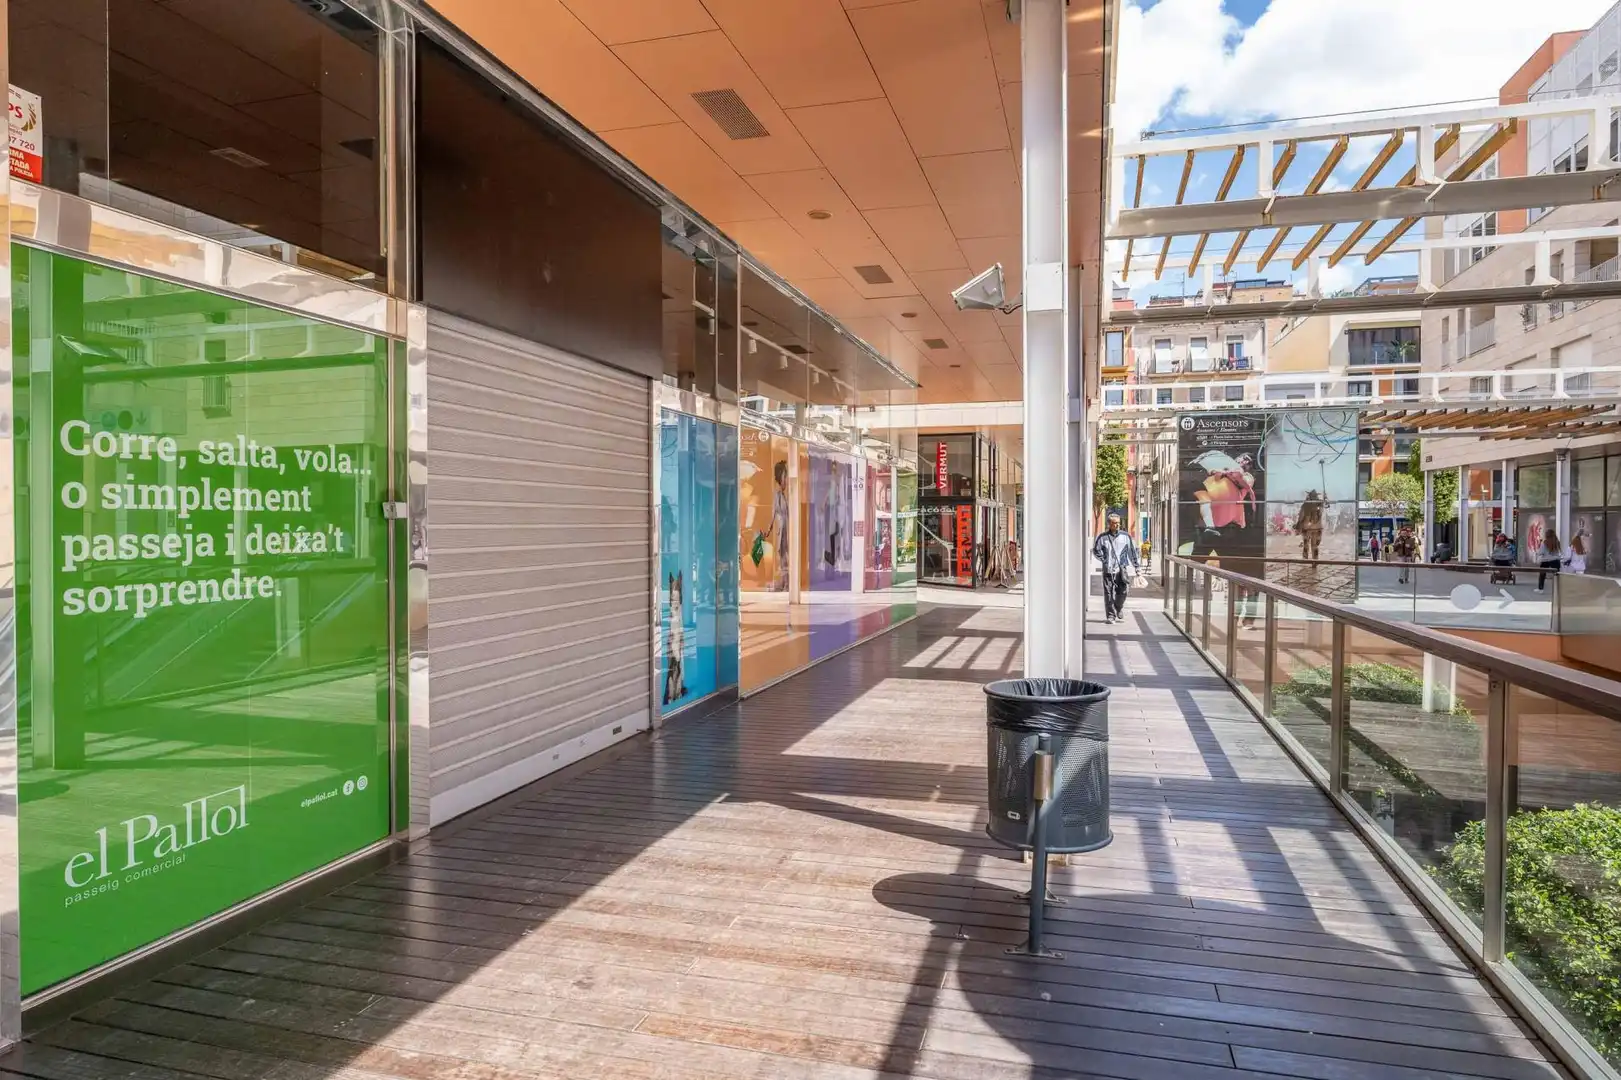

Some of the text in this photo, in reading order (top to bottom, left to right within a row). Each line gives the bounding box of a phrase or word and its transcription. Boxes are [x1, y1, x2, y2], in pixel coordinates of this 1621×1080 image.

[19, 139, 35, 151] 720
[1197, 418, 1249, 428] Ascensors
[60, 420, 372, 476] Corre, salta, vola...
[939, 442, 947, 489] VERMUT
[61, 474, 312, 519] o simplement
[61, 523, 344, 572] passeja i deixa't
[62, 568, 283, 618] sorprendre.
[300, 788, 339, 808] elpallol.cat
[64, 784, 250, 888] el Pallol
[64, 853, 187, 908] passeig comercial
